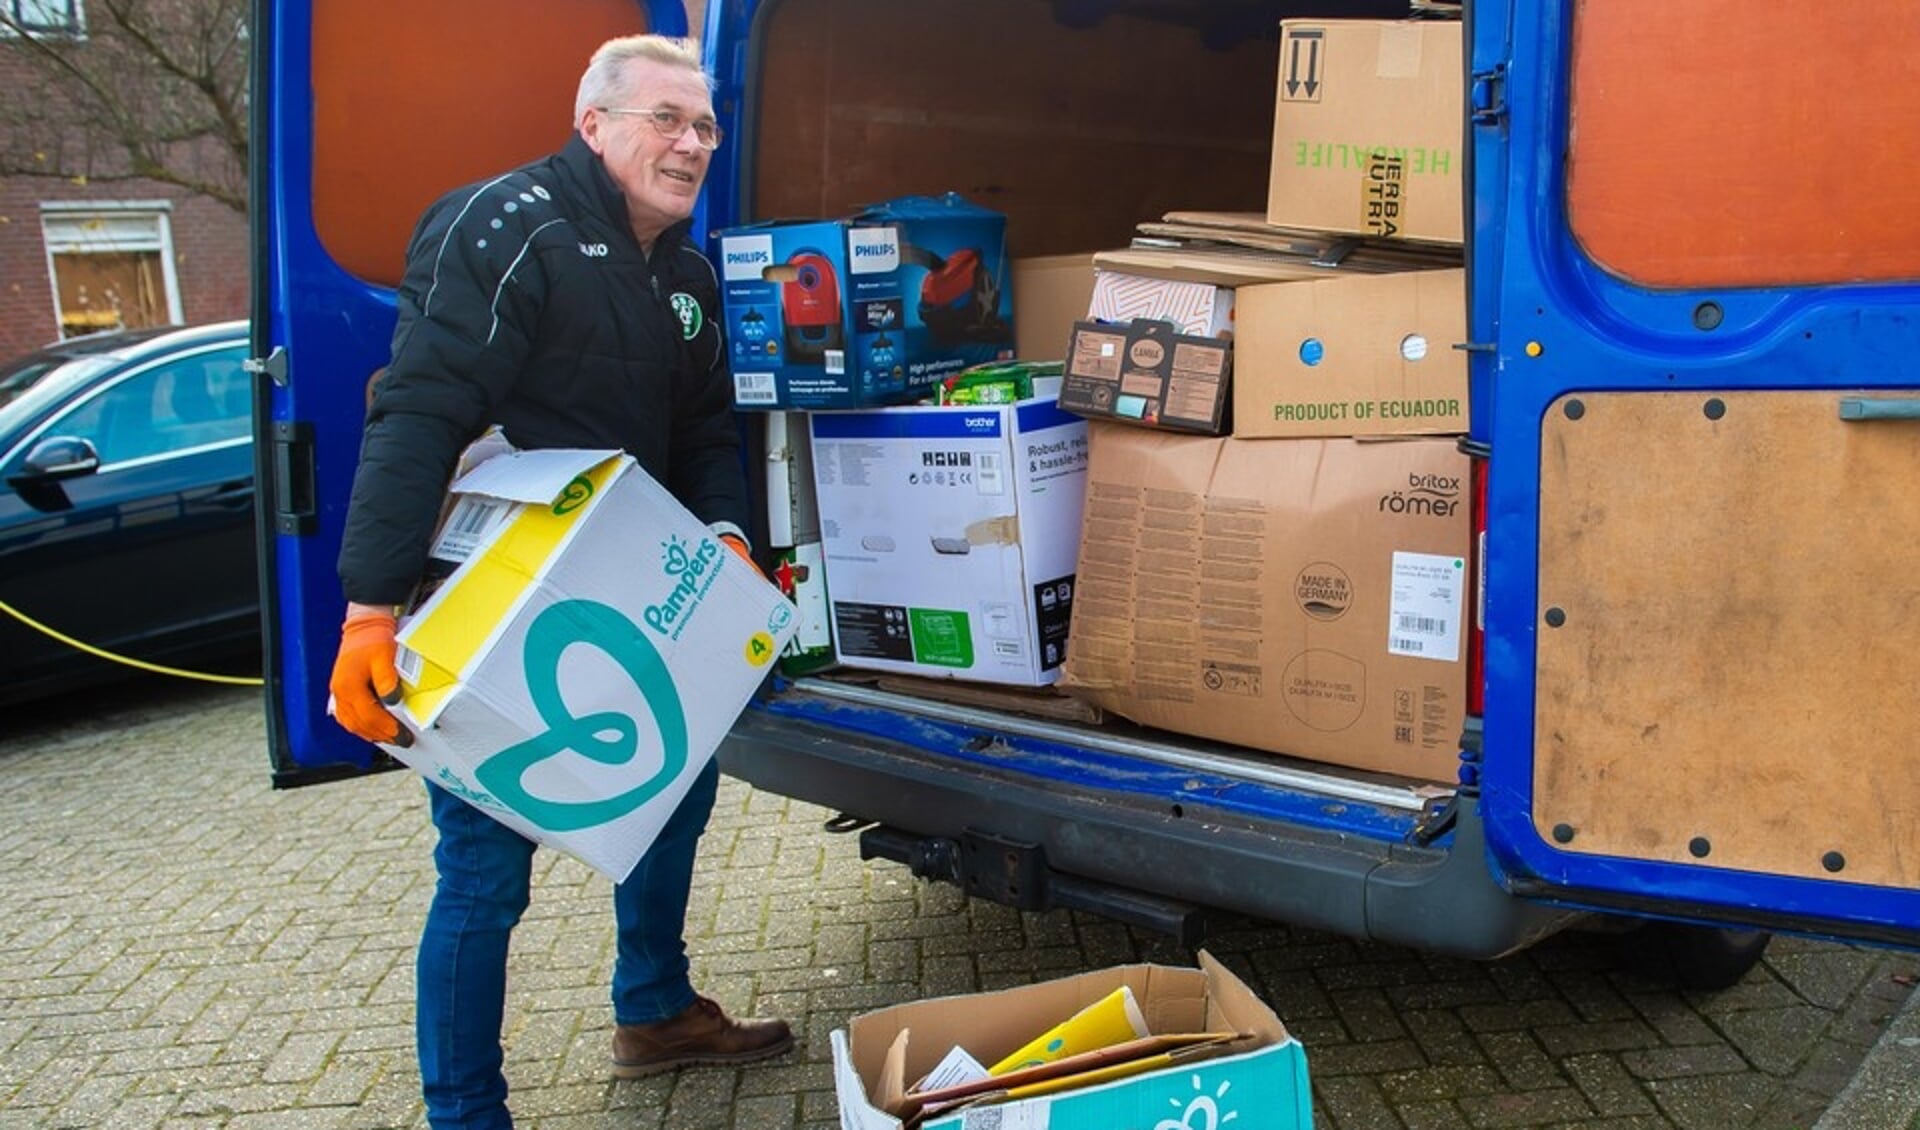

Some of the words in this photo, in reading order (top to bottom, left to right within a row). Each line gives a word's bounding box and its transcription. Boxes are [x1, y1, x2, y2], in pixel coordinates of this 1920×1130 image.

[578, 241, 608, 257] AKO
[855, 243, 896, 256] PHILIPS
[727, 251, 769, 264] PHILIPS
[1275, 402, 1348, 421] PRODUCT
[1354, 402, 1374, 419] OF
[1380, 399, 1459, 418] ECUADOR
[965, 417, 996, 427] brother
[1028, 440, 1069, 457] Robust,
[1030, 460, 1037, 473] &
[1409, 472, 1460, 490] britax
[1379, 491, 1459, 517] römer
[644, 538, 717, 635] Pampers
[1302, 575, 1332, 588] MADE
[1334, 578, 1346, 589] IN
[1298, 587, 1349, 601] GERMANY
[752, 638, 766, 656] 4
